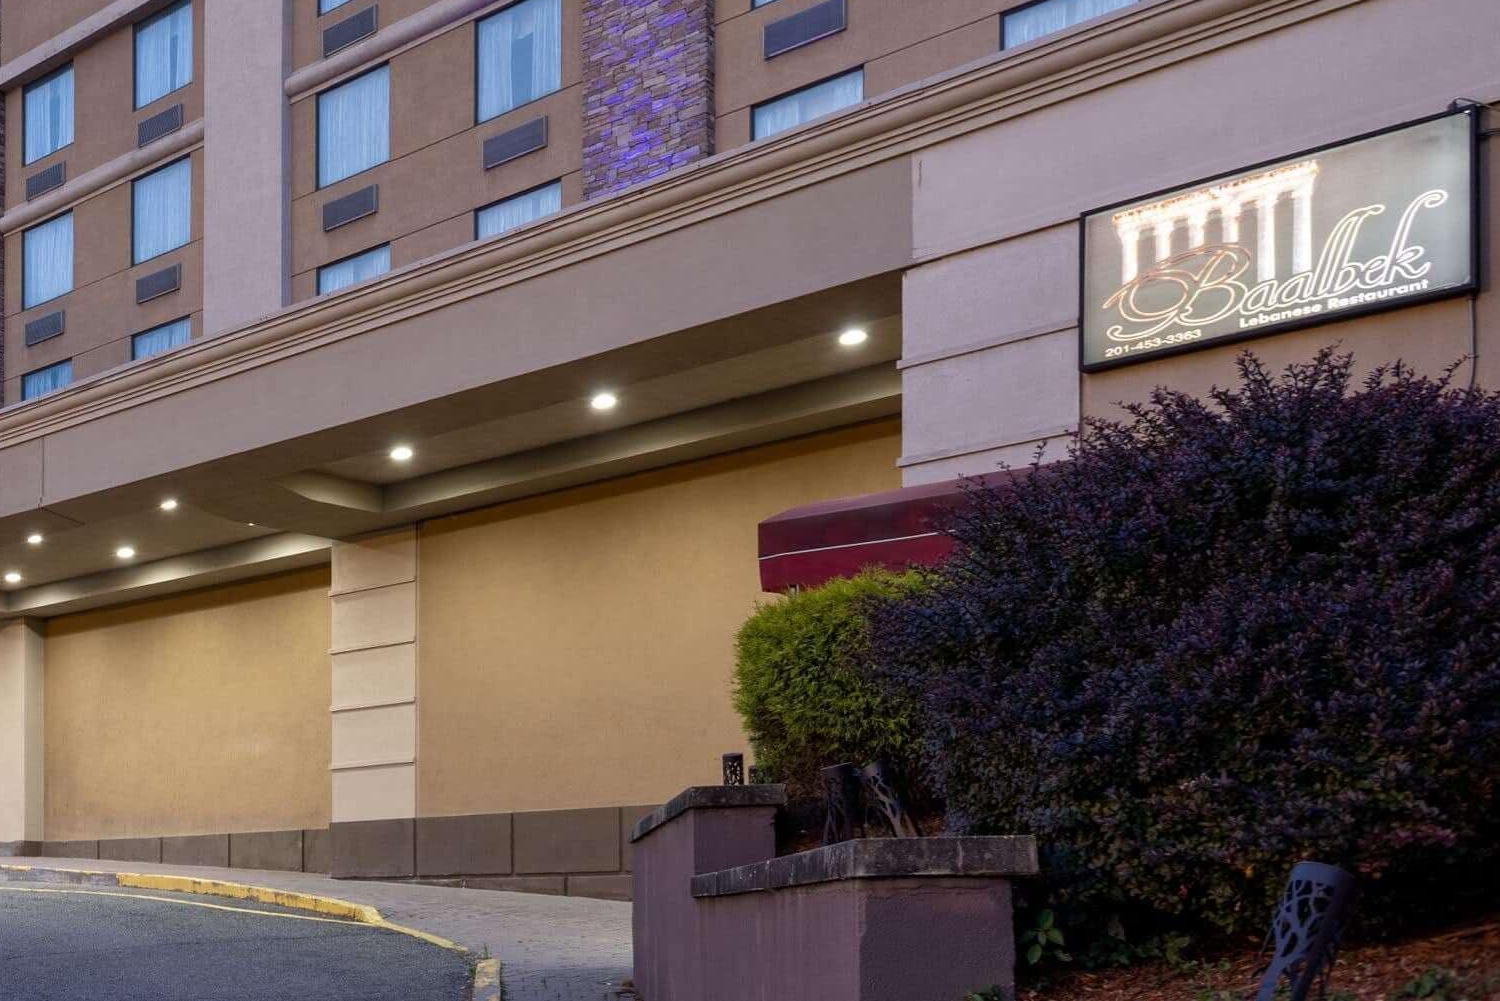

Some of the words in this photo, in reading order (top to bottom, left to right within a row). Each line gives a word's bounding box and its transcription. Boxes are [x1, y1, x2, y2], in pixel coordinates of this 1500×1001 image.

[1102, 189, 1449, 341] Baalbek
[1238, 303, 1323, 328] Lebanese
[1328, 279, 1429, 310] Restaurant
